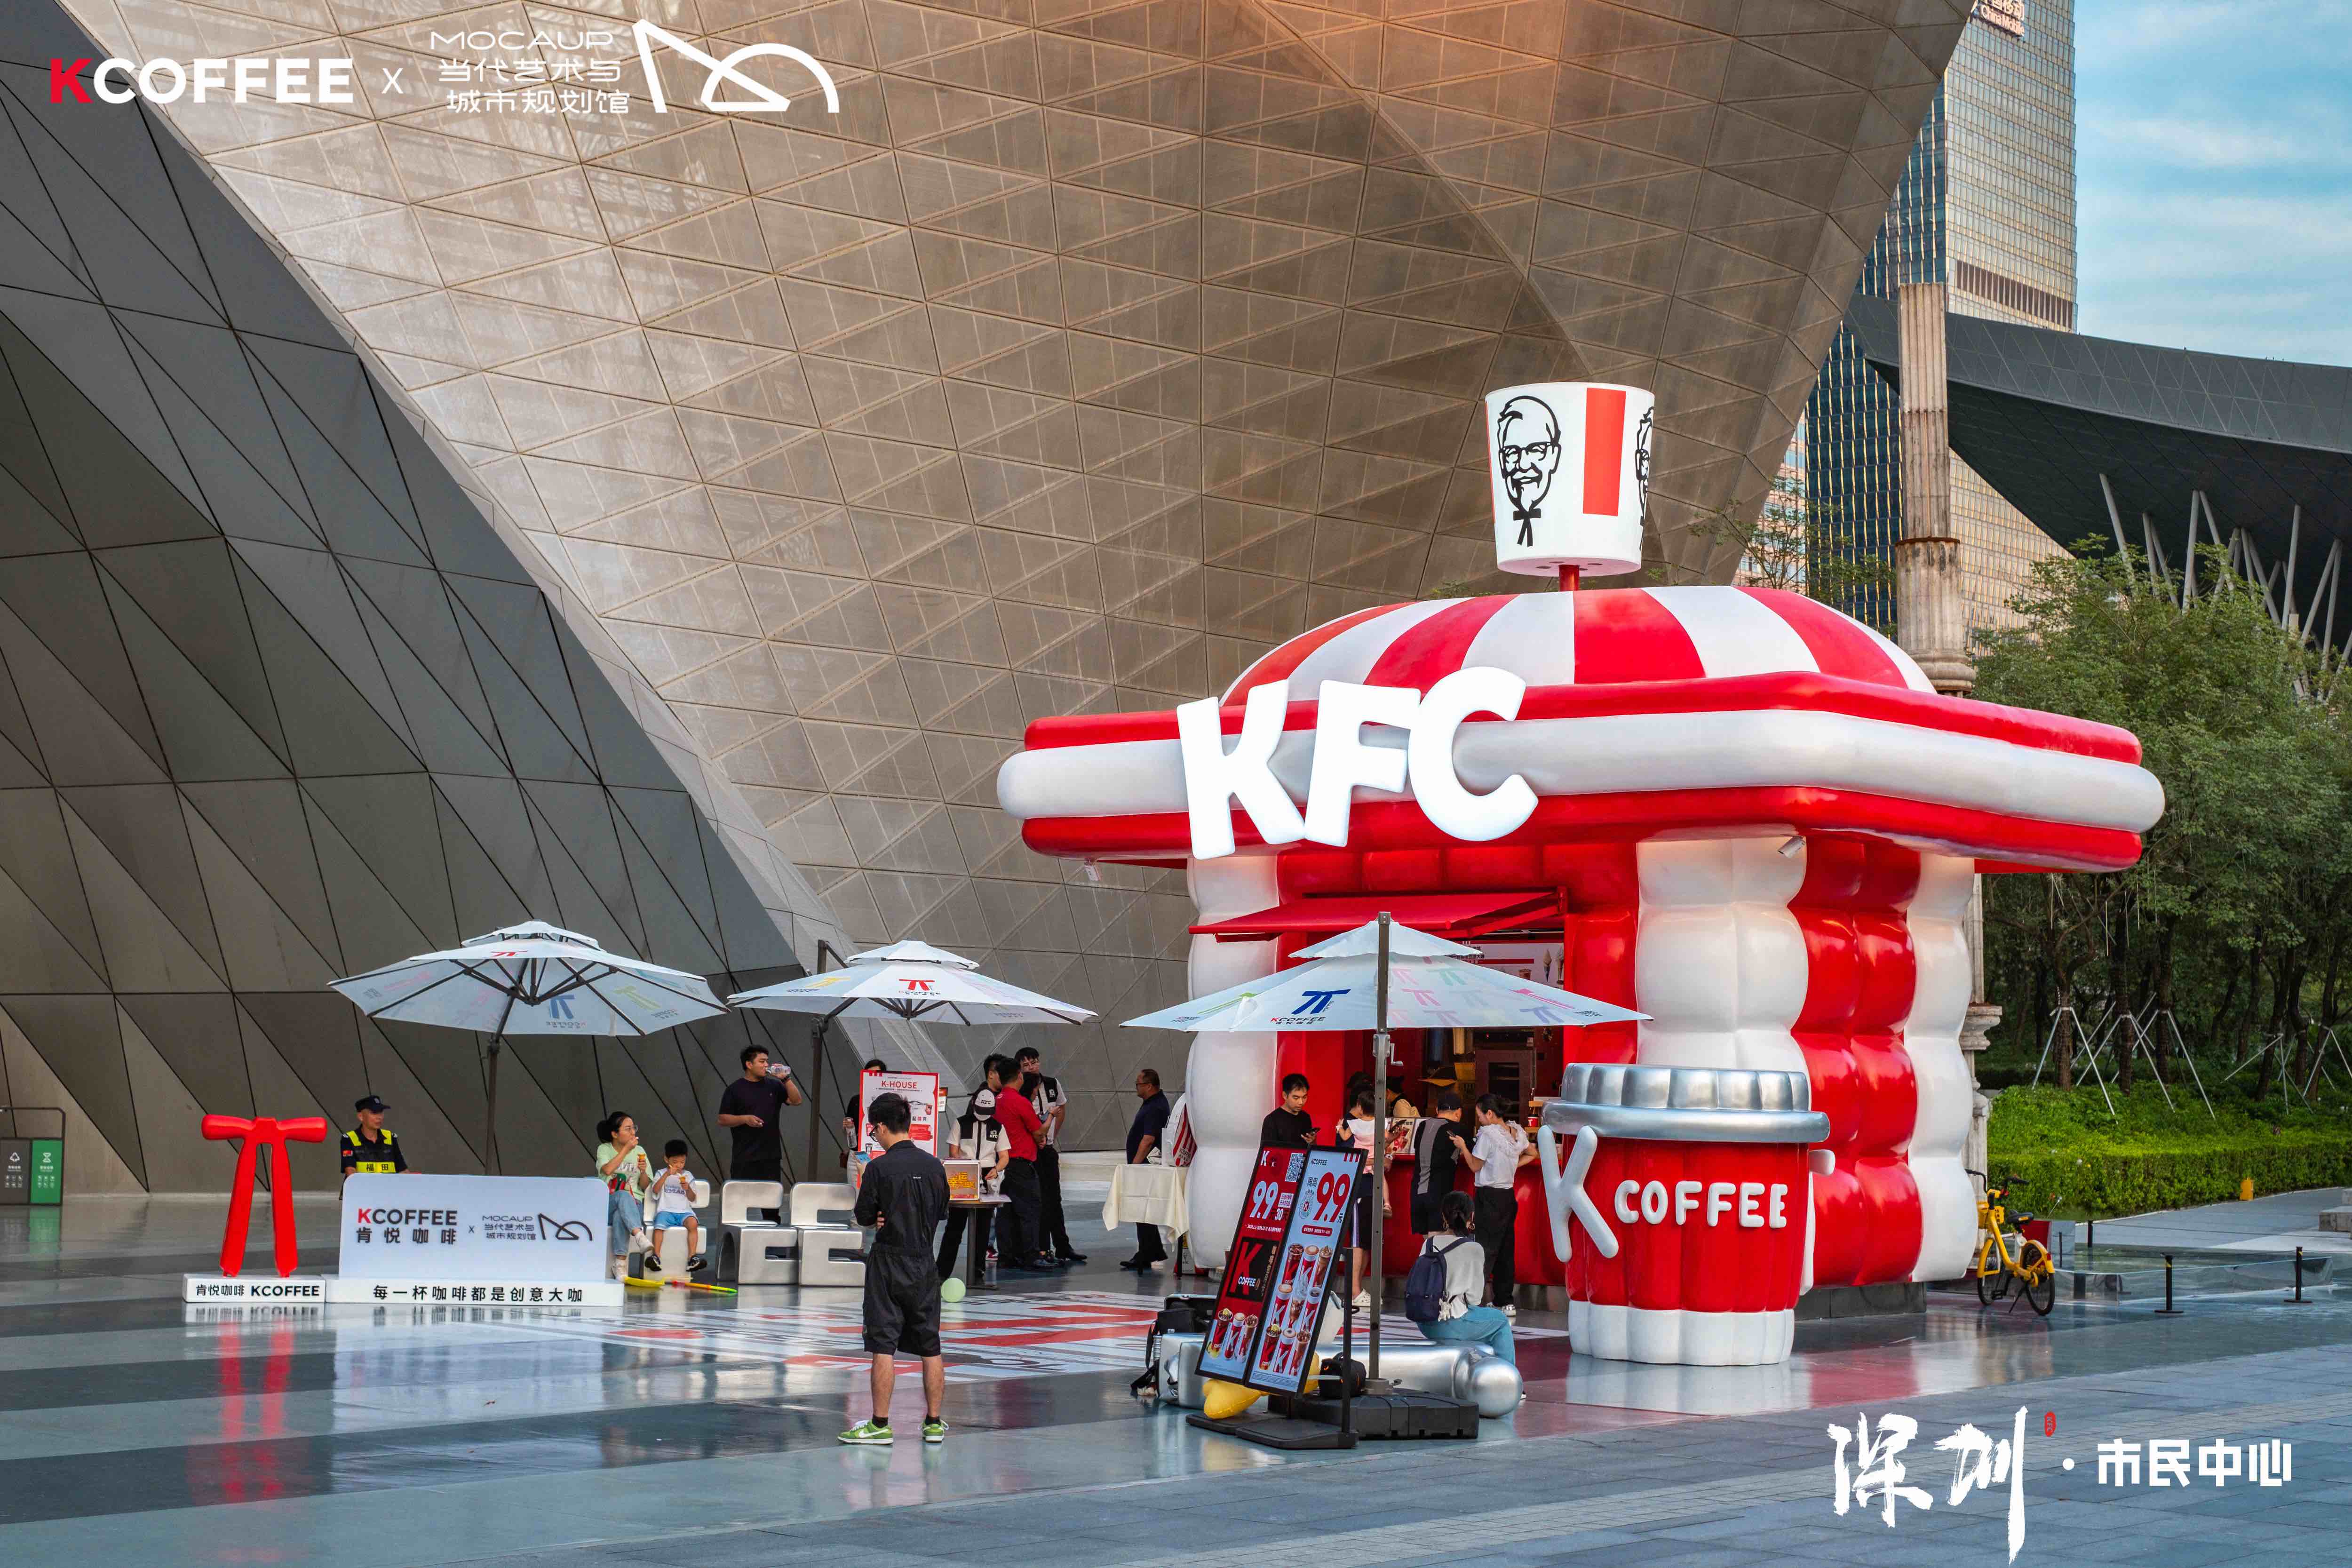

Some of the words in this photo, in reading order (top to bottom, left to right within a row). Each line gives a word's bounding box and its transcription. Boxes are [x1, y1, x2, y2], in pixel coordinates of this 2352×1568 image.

[1177, 667, 1539, 860] KFC
[1313, 1172, 1351, 1223] 9.9
[1537, 1125, 1619, 1263] K
[1614, 1180, 1788, 1229] COFFEE
[358, 1208, 458, 1226] KCOFFEE
[356, 1226, 457, 1245] 肯悦咖啡
[486, 1232, 536, 1241] 城市规划馆
[1230, 1242, 1263, 1295] K
[195, 1284, 245, 1297] 肯悦咖啡
[250, 1285, 320, 1297] KCOFFEE
[1238, 1276, 1256, 1287] COFFEE
[373, 1284, 583, 1303] 每一杯咖啡都是创意大咖
